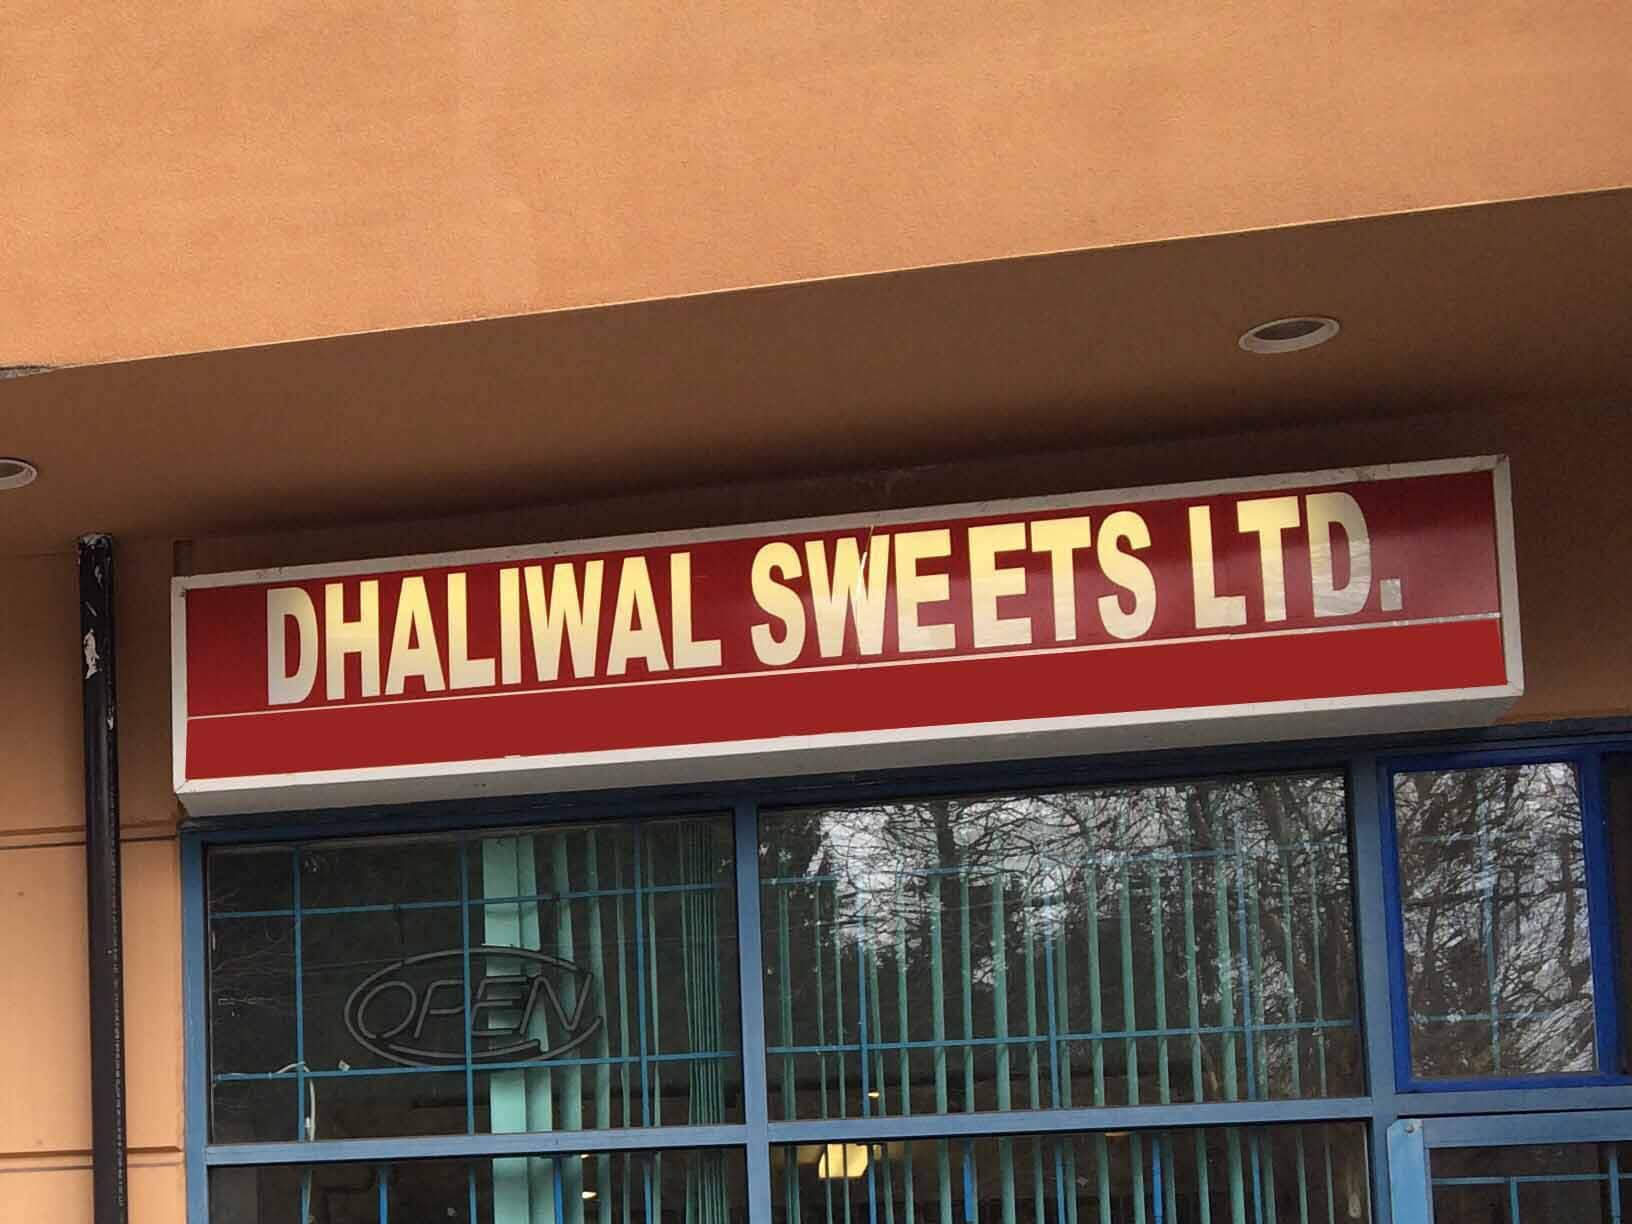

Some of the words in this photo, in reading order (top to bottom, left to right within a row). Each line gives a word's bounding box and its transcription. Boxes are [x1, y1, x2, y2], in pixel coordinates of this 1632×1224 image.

[265, 542, 720, 706] DHALIWAL
[749, 511, 1156, 665] SWEETS
[1185, 491, 1402, 628] LTD.
[358, 972, 593, 1039] OPEN
